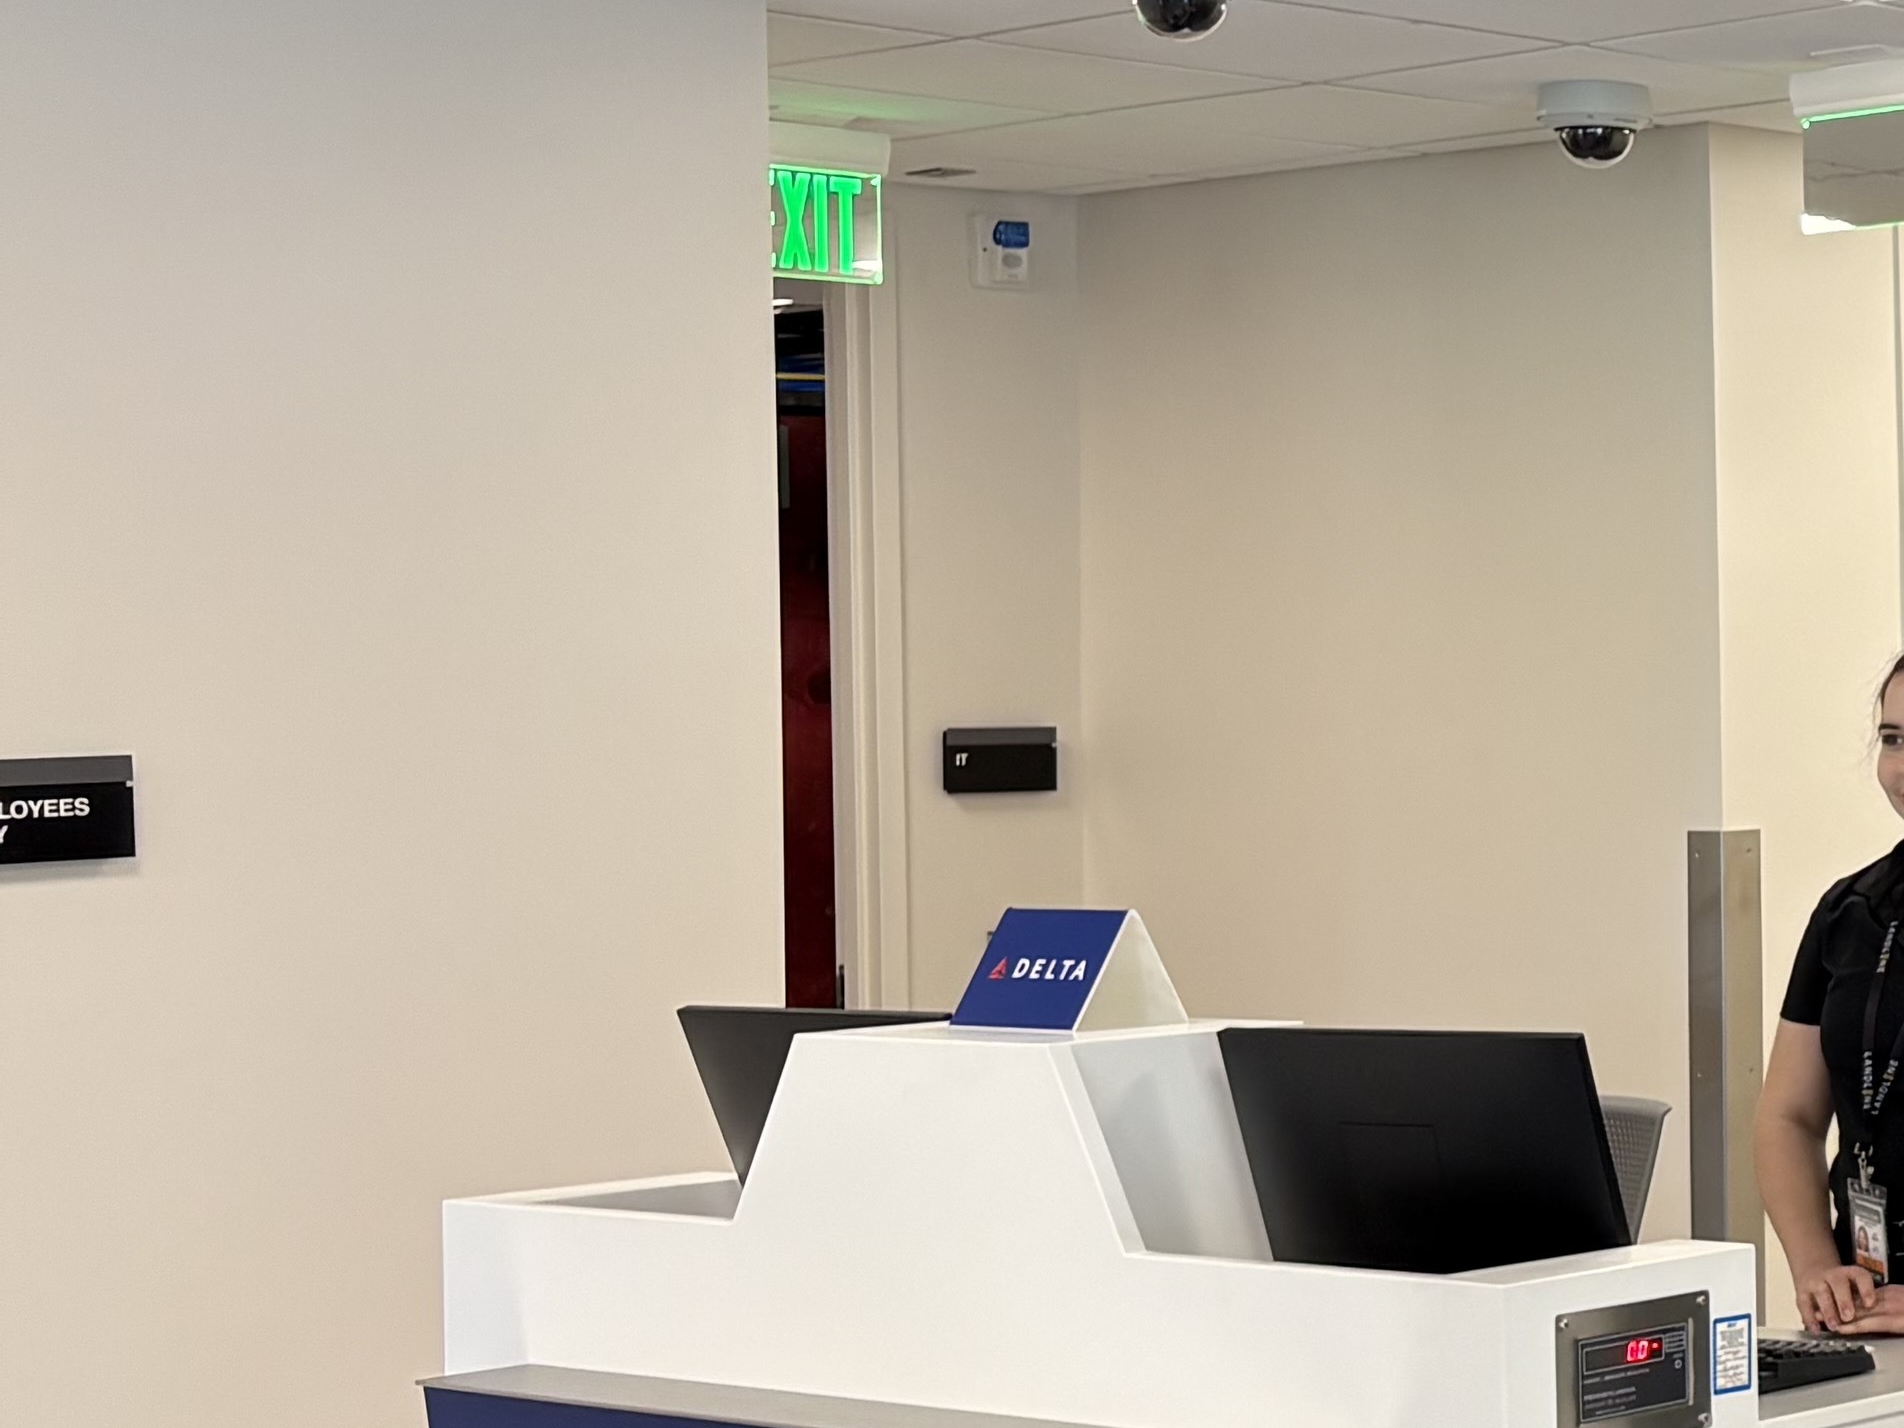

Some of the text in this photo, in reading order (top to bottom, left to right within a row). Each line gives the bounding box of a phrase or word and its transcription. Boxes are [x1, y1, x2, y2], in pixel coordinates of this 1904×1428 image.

[769, 169, 862, 274] XIT
[955, 752, 968, 766] IT
[1011, 957, 1087, 981] DELTA
